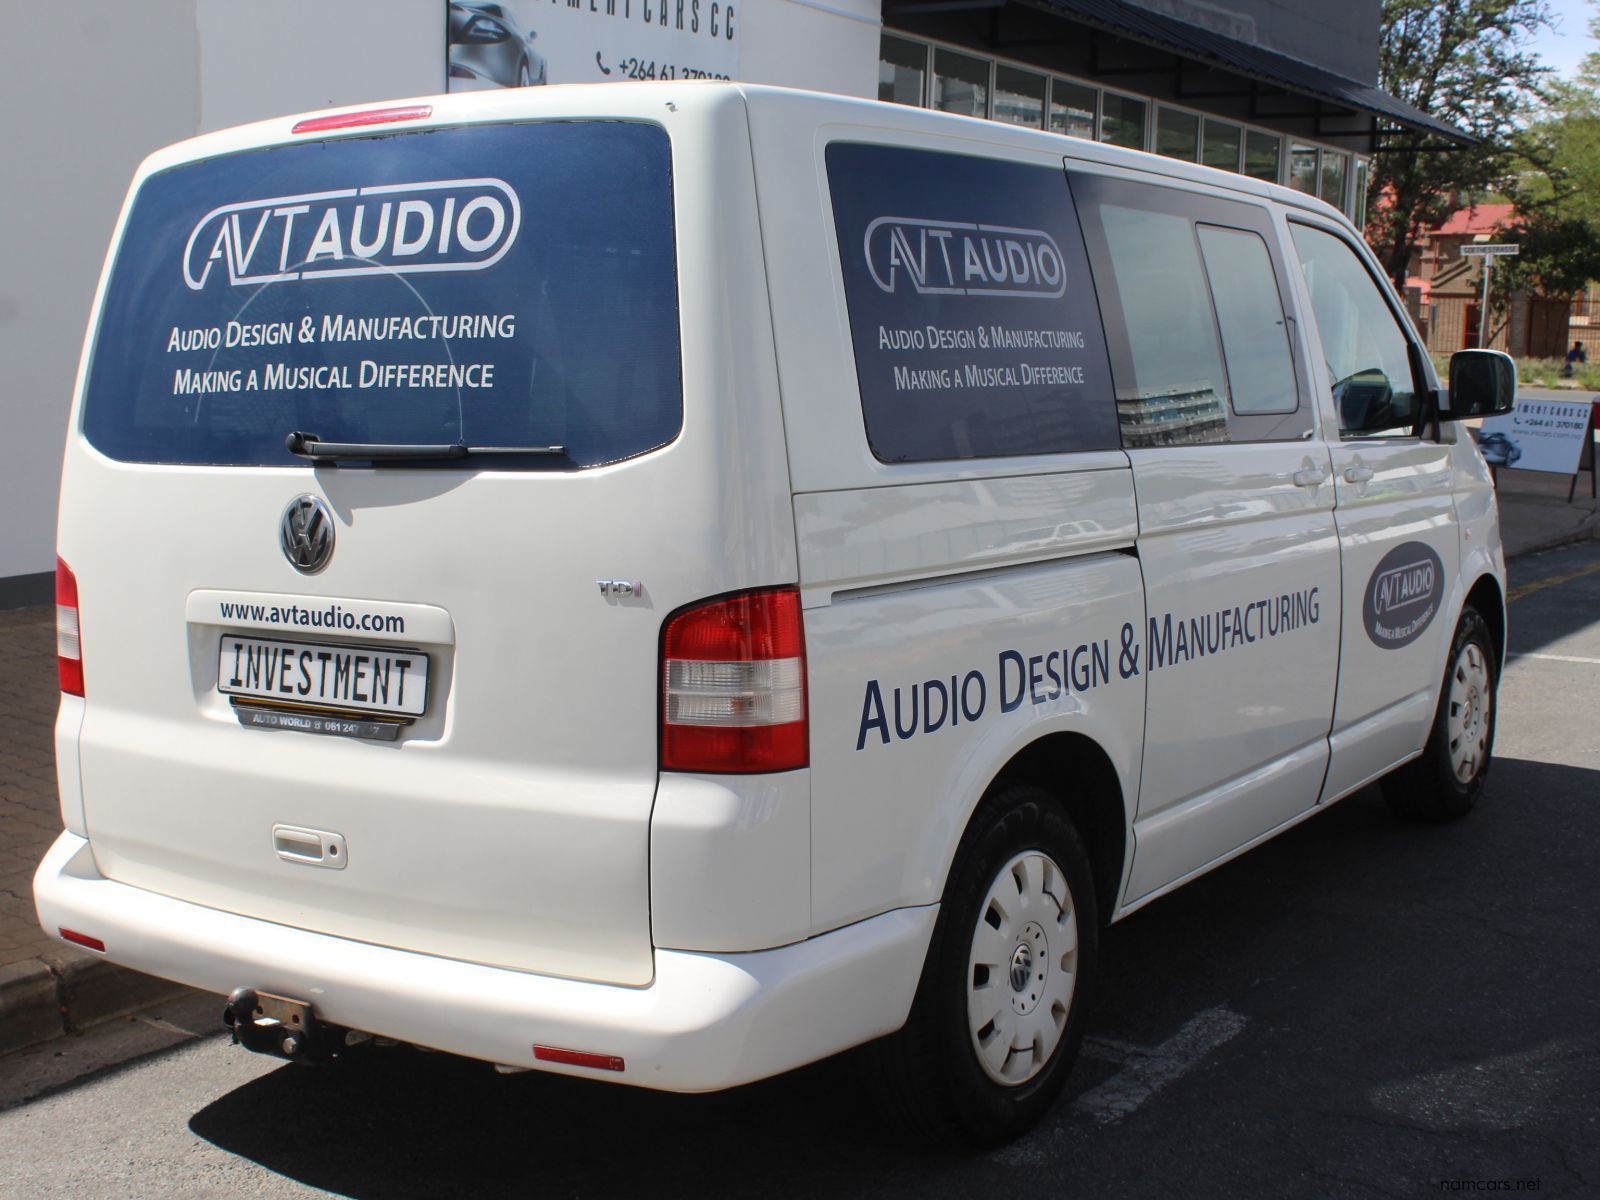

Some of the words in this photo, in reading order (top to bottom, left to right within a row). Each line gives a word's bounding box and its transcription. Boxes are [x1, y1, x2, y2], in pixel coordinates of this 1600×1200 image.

[643, 0, 700, 33] CARS
[710, 2, 734, 41] CC
[619, 57, 655, 80] +264
[660, 64, 676, 80] 61
[167, 326, 221, 352] AUDIO
[224, 320, 293, 348] DESIGN
[298, 315, 315, 343] &
[321, 314, 515, 342] MANUFACTURING
[879, 325, 924, 350] AUDIO
[926, 325, 976, 349] DESIGN
[977, 325, 990, 349] &
[990, 326, 1084, 349] MANUFACTURING
[173, 368, 241, 395] MAKING
[246, 369, 259, 391] A
[263, 363, 352, 391] MUSICAL
[358, 360, 495, 388] DIFFERENCE
[894, 366, 951, 390] MAKING
[954, 369, 963, 388] A
[964, 364, 1020, 388] MUSICAL
[1020, 363, 1084, 385] DIFFERENCE
[220, 602, 405, 633] www.avtaudio.com
[230, 643, 411, 706] INVESTMENT
[855, 668, 986, 751] AUDIO
[998, 638, 1110, 714] DESIGN
[1118, 622, 1141, 679] &
[1148, 586, 1320, 672] MANUFACTURING
[253, 714, 277, 726] AUTO
[279, 716, 311, 729] WORLD
[324, 721, 341, 732] 061
